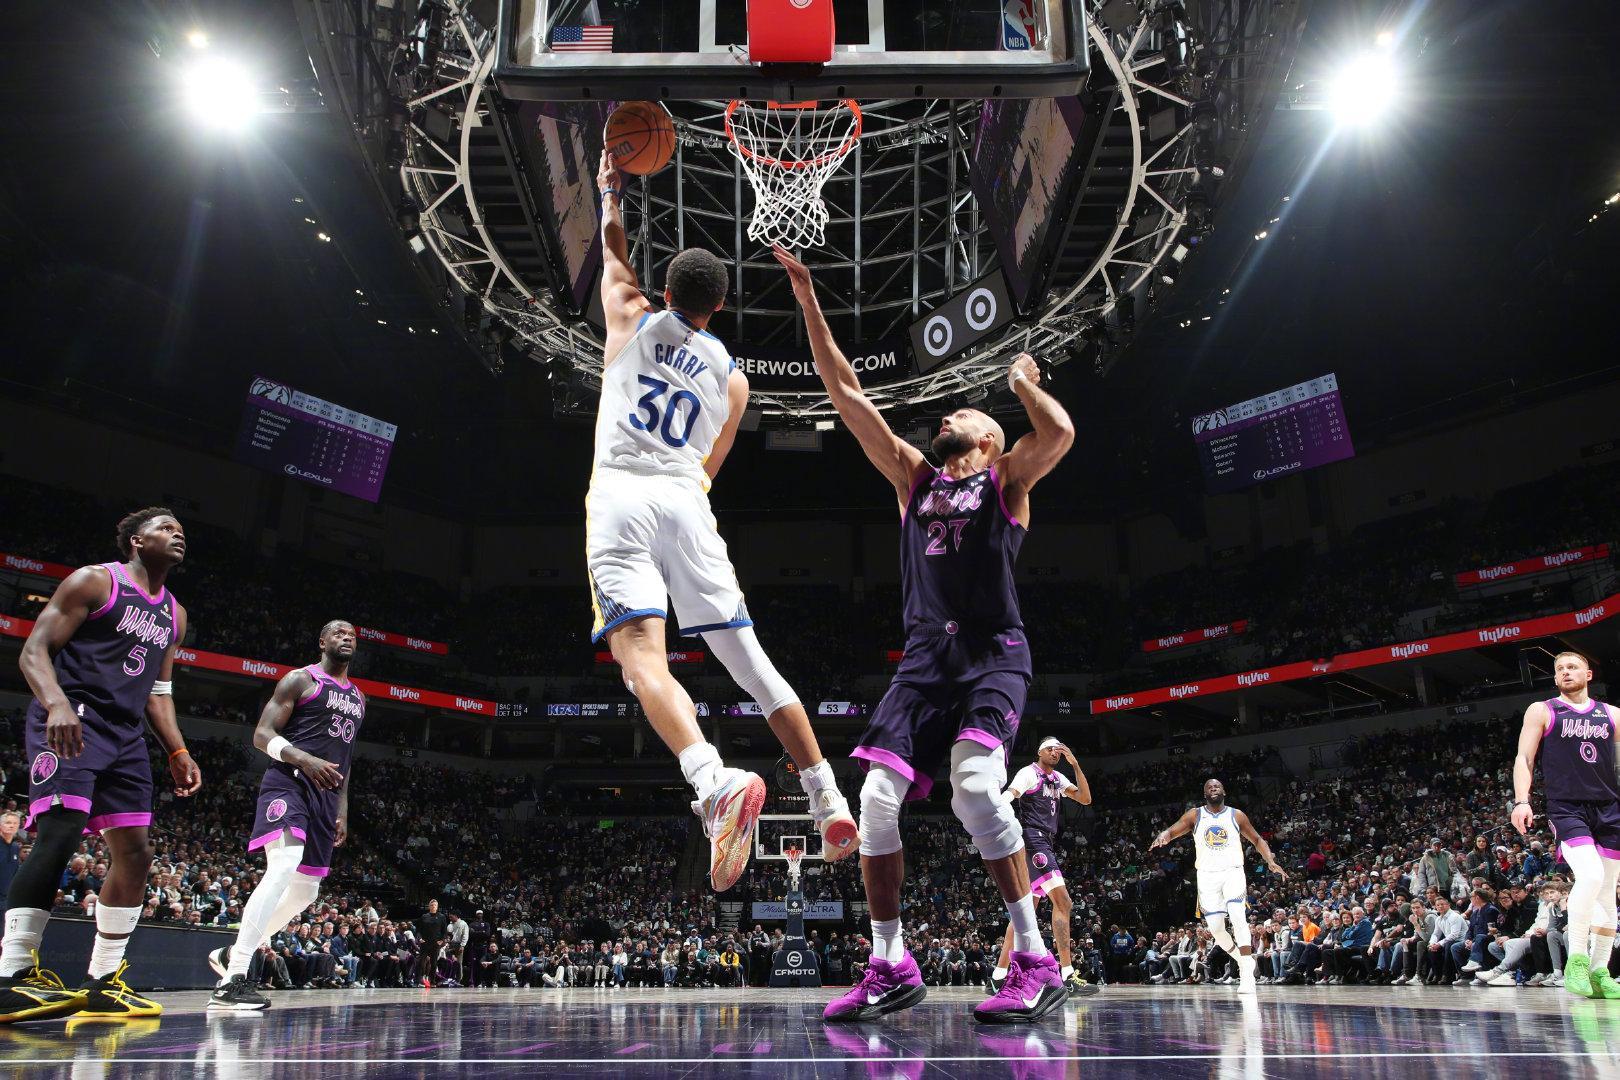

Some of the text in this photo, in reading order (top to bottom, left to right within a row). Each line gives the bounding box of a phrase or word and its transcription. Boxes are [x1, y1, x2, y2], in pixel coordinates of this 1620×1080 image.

[1008, 37, 1025, 48] NBA
[655, 343, 708, 379] CURRY
[629, 373, 700, 448] 30
[298, 470, 332, 484] LEXUS
[1266, 462, 1302, 476] LEXUS
[925, 518, 971, 556] 27
[1478, 551, 1582, 580] HyVee HyVee
[116, 605, 172, 649] Wolves
[407, 637, 432, 650] HyVee
[1158, 635, 1184, 648] HyVee
[122, 644, 148, 676] 5
[1106, 605, 1605, 710] HyVee HyVee HyVee HyVee HyVee HyVee
[174, 649, 483, 711] Vee HyVee HyVee HyVee
[326, 690, 362, 719] Wolves
[499, 703, 511, 711] SAC
[547, 704, 580, 716] KFAN
[826, 703, 839, 713] 53
[328, 713, 356, 743] 30
[1560, 718, 1610, 740] Wolves
[1579, 741, 1598, 763] 0
[804, 905, 835, 913] ULTRA
[775, 968, 816, 976] CFMOTO
